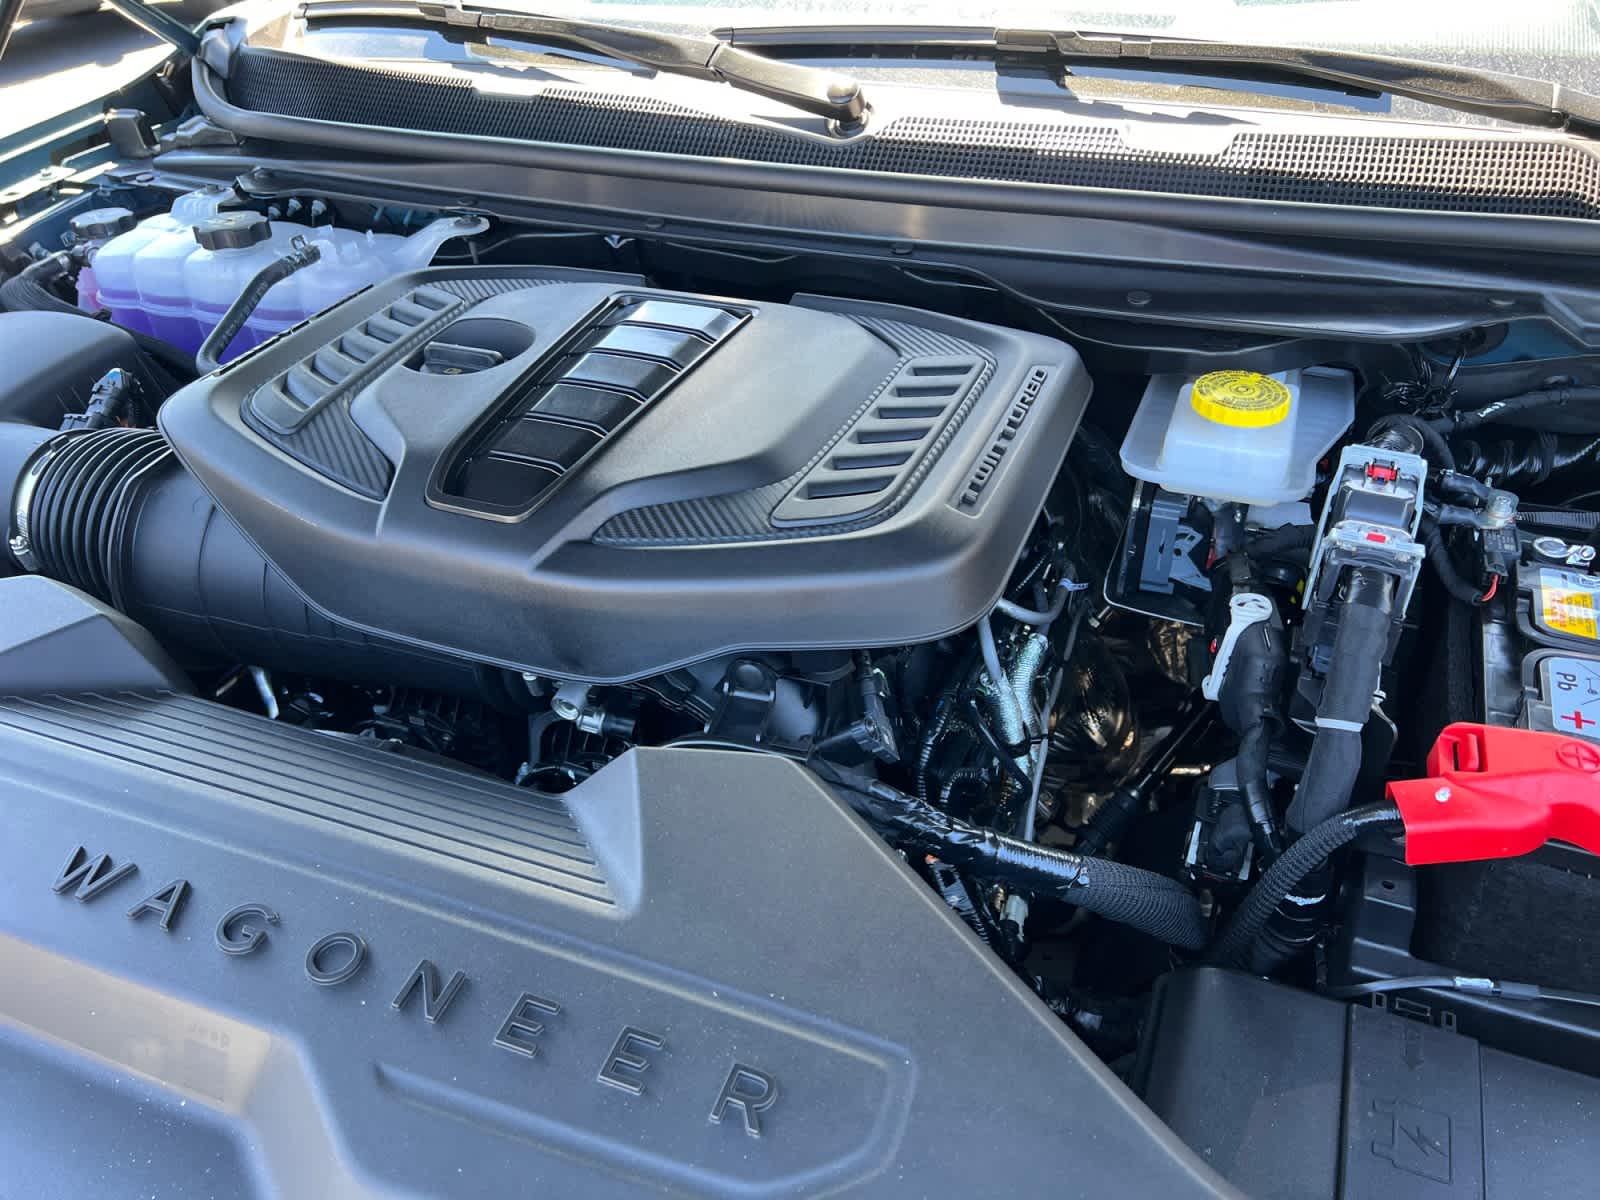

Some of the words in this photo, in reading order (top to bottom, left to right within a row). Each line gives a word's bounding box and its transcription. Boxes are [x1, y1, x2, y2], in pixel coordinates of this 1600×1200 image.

[957, 442, 1008, 507] TWIN
[998, 369, 1047, 442] TURBO
[1556, 671, 1578, 691] Pb
[52, 845, 779, 1138] WAGONEER
